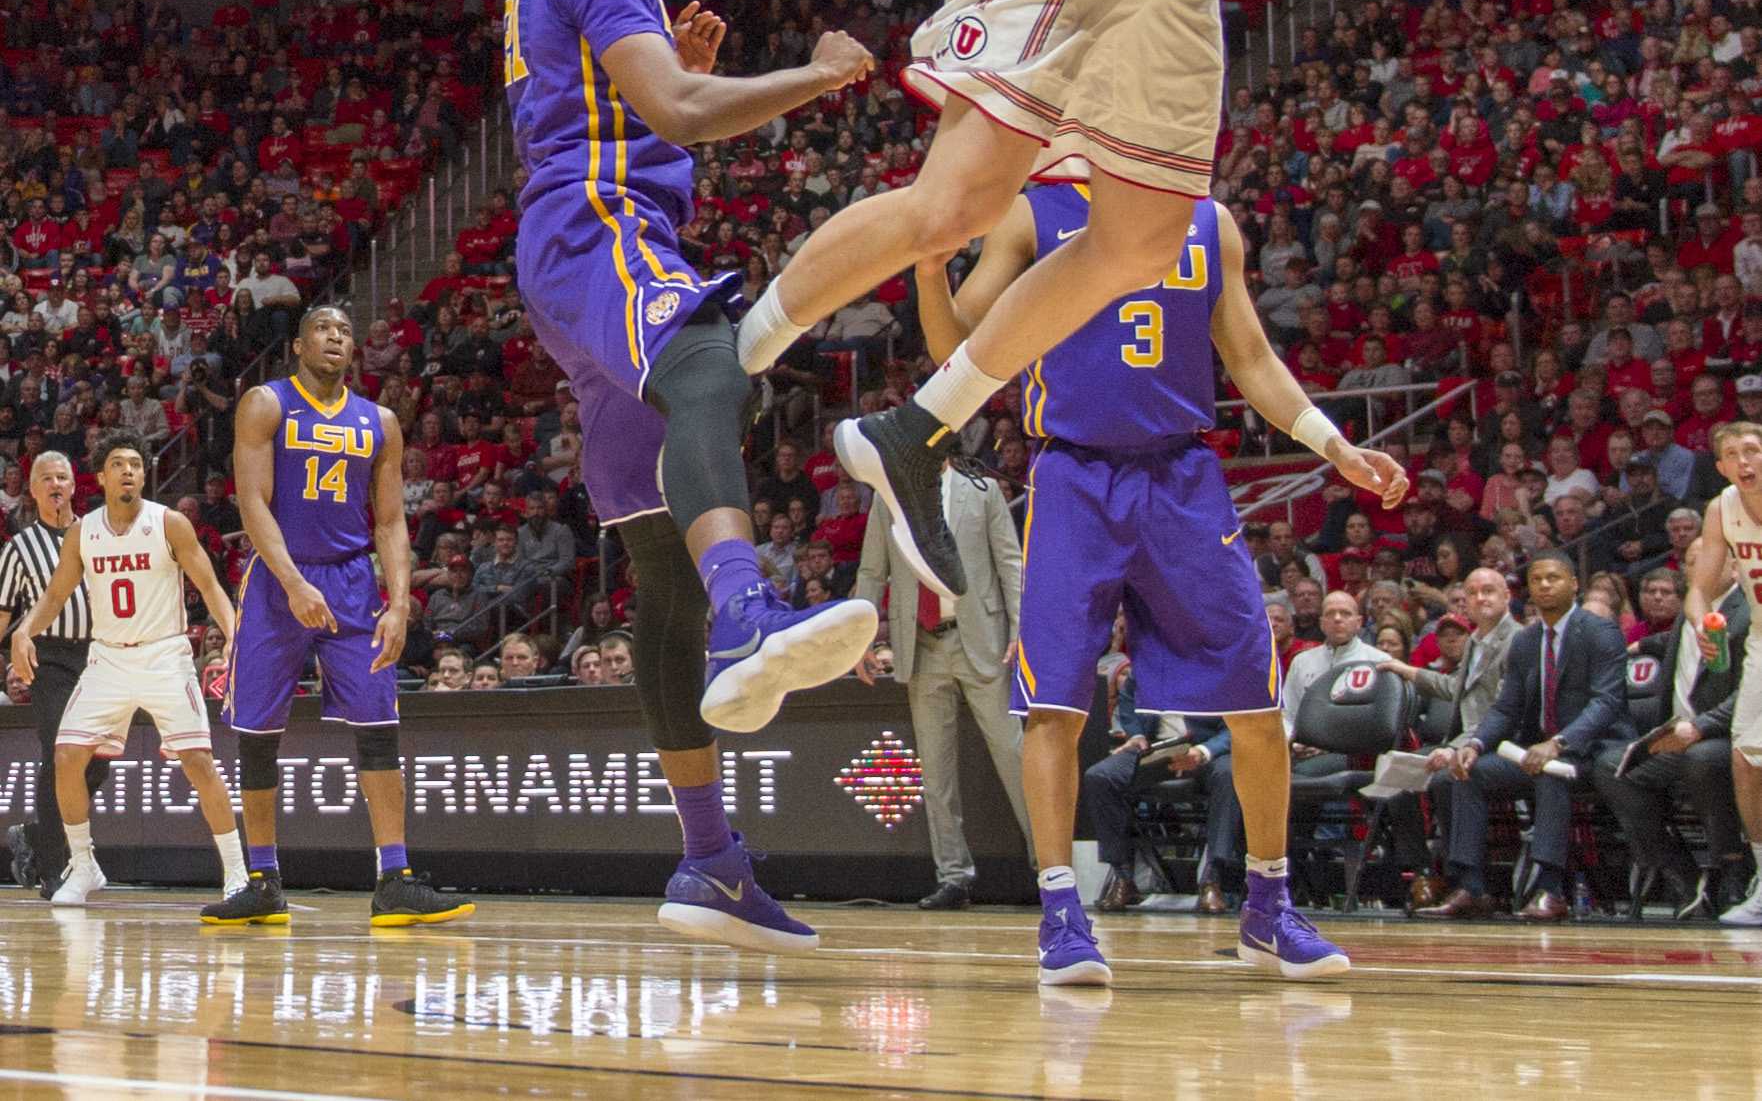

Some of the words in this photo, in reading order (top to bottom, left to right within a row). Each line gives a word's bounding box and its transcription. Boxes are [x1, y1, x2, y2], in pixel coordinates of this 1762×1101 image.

[957, 22, 982, 55] U
[1119, 300, 1163, 368] 3
[285, 418, 373, 458] LSU
[303, 456, 348, 502] 14
[92, 553, 151, 574] UTAH
[111, 579, 136, 618] 0
[1351, 670, 1371, 689] U
[1634, 662, 1654, 682] U
[276, 750, 793, 813] TORNAMET
